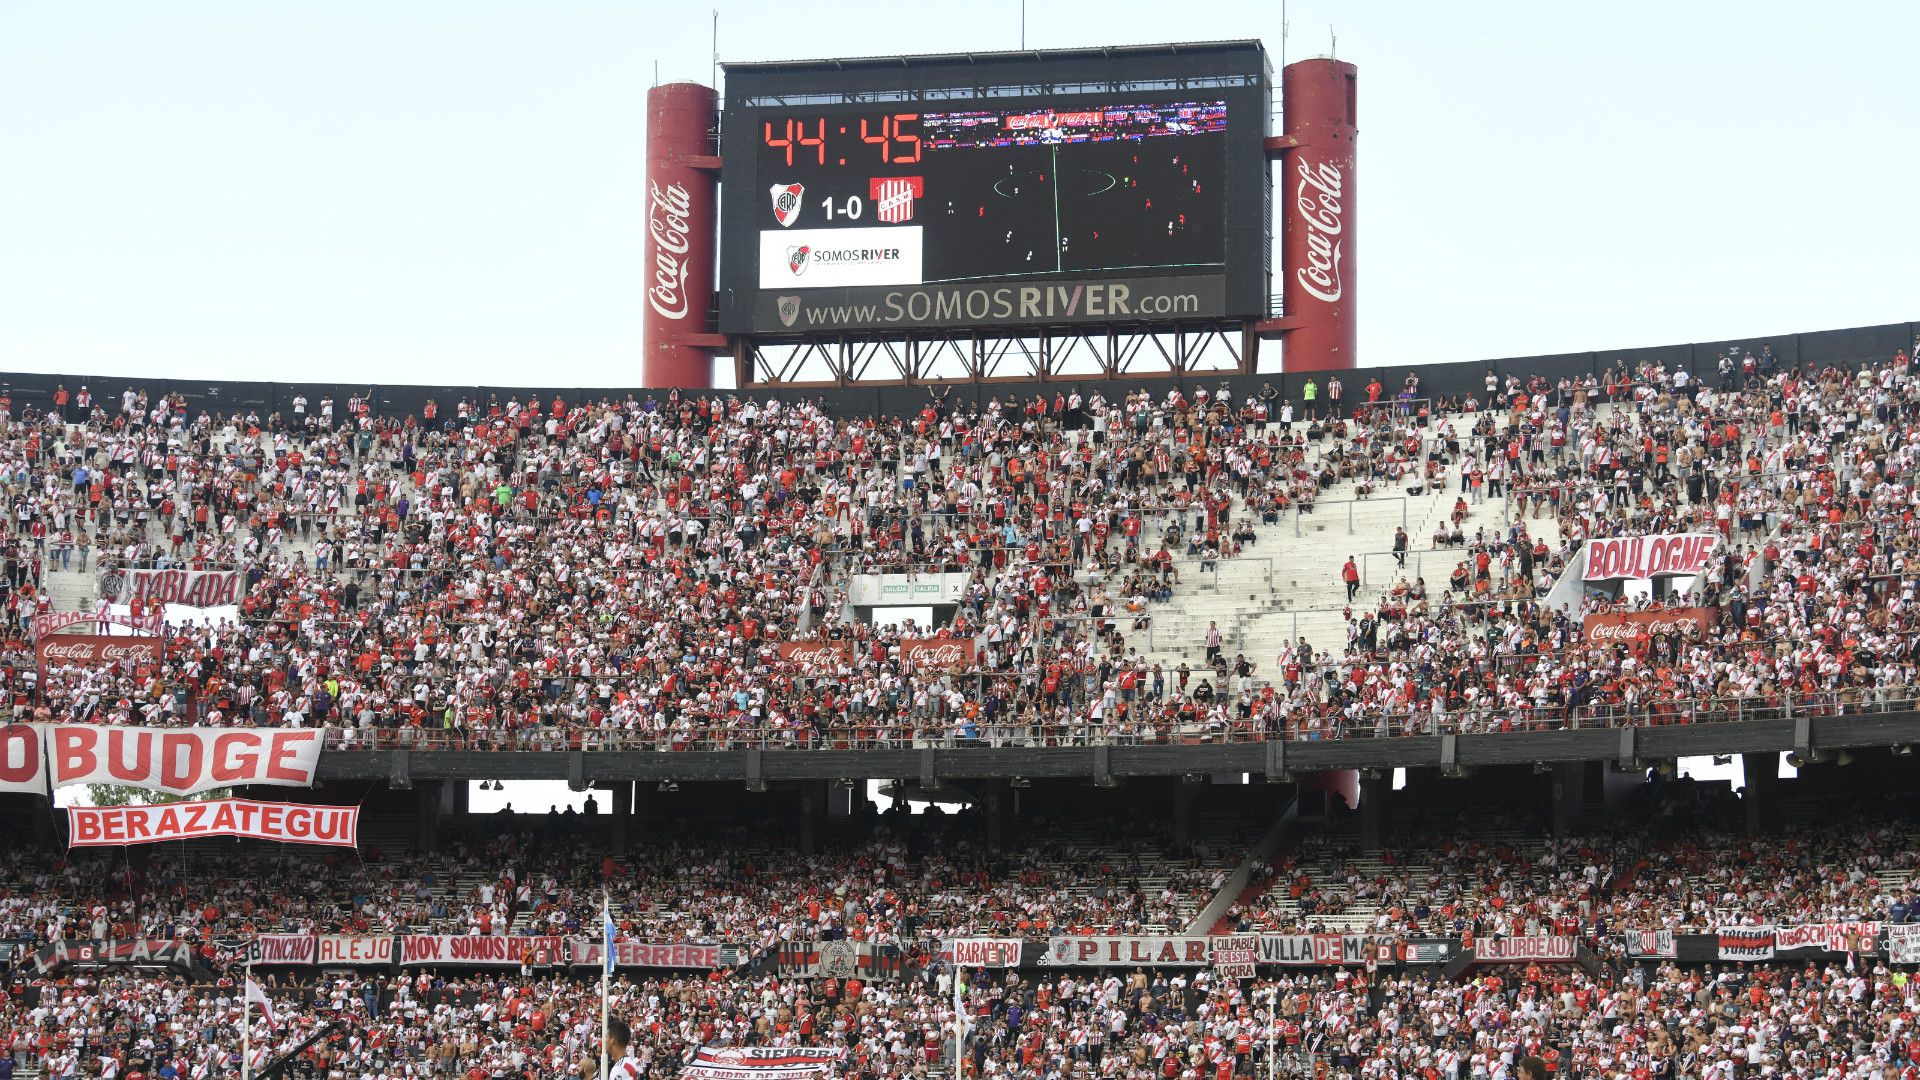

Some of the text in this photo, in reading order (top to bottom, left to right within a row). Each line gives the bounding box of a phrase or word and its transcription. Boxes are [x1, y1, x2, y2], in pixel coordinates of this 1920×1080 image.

[765, 113, 921, 167] 44:45
[821, 195, 862, 220] 1-0
[1297, 155, 1342, 303] Coca-Cola
[648, 177, 690, 320] Coca-Cola
[1585, 536, 1714, 579] BOULOGNE
[134, 569, 238, 609] TABLADA
[884, 585, 938, 593] SALIDA SALIDA
[44, 642, 96, 659] Coca-Cola
[54, 728, 316, 790] BUDGE
[76, 803, 350, 841] BERAZATEGUI
[262, 936, 313, 961] TINCHO
[321, 938, 391, 960] ALEJO
[402, 936, 443, 961] MOV.
[450, 936, 504, 961] SOMOS
[570, 943, 718, 967] LAERRERE
[1078, 940, 1206, 962] PILAR
[1218, 951, 1229, 962] DE
[1260, 937, 1314, 960] VILLA
[1316, 937, 1340, 960] DE
[750, 1048, 832, 1059] SIEMPR
